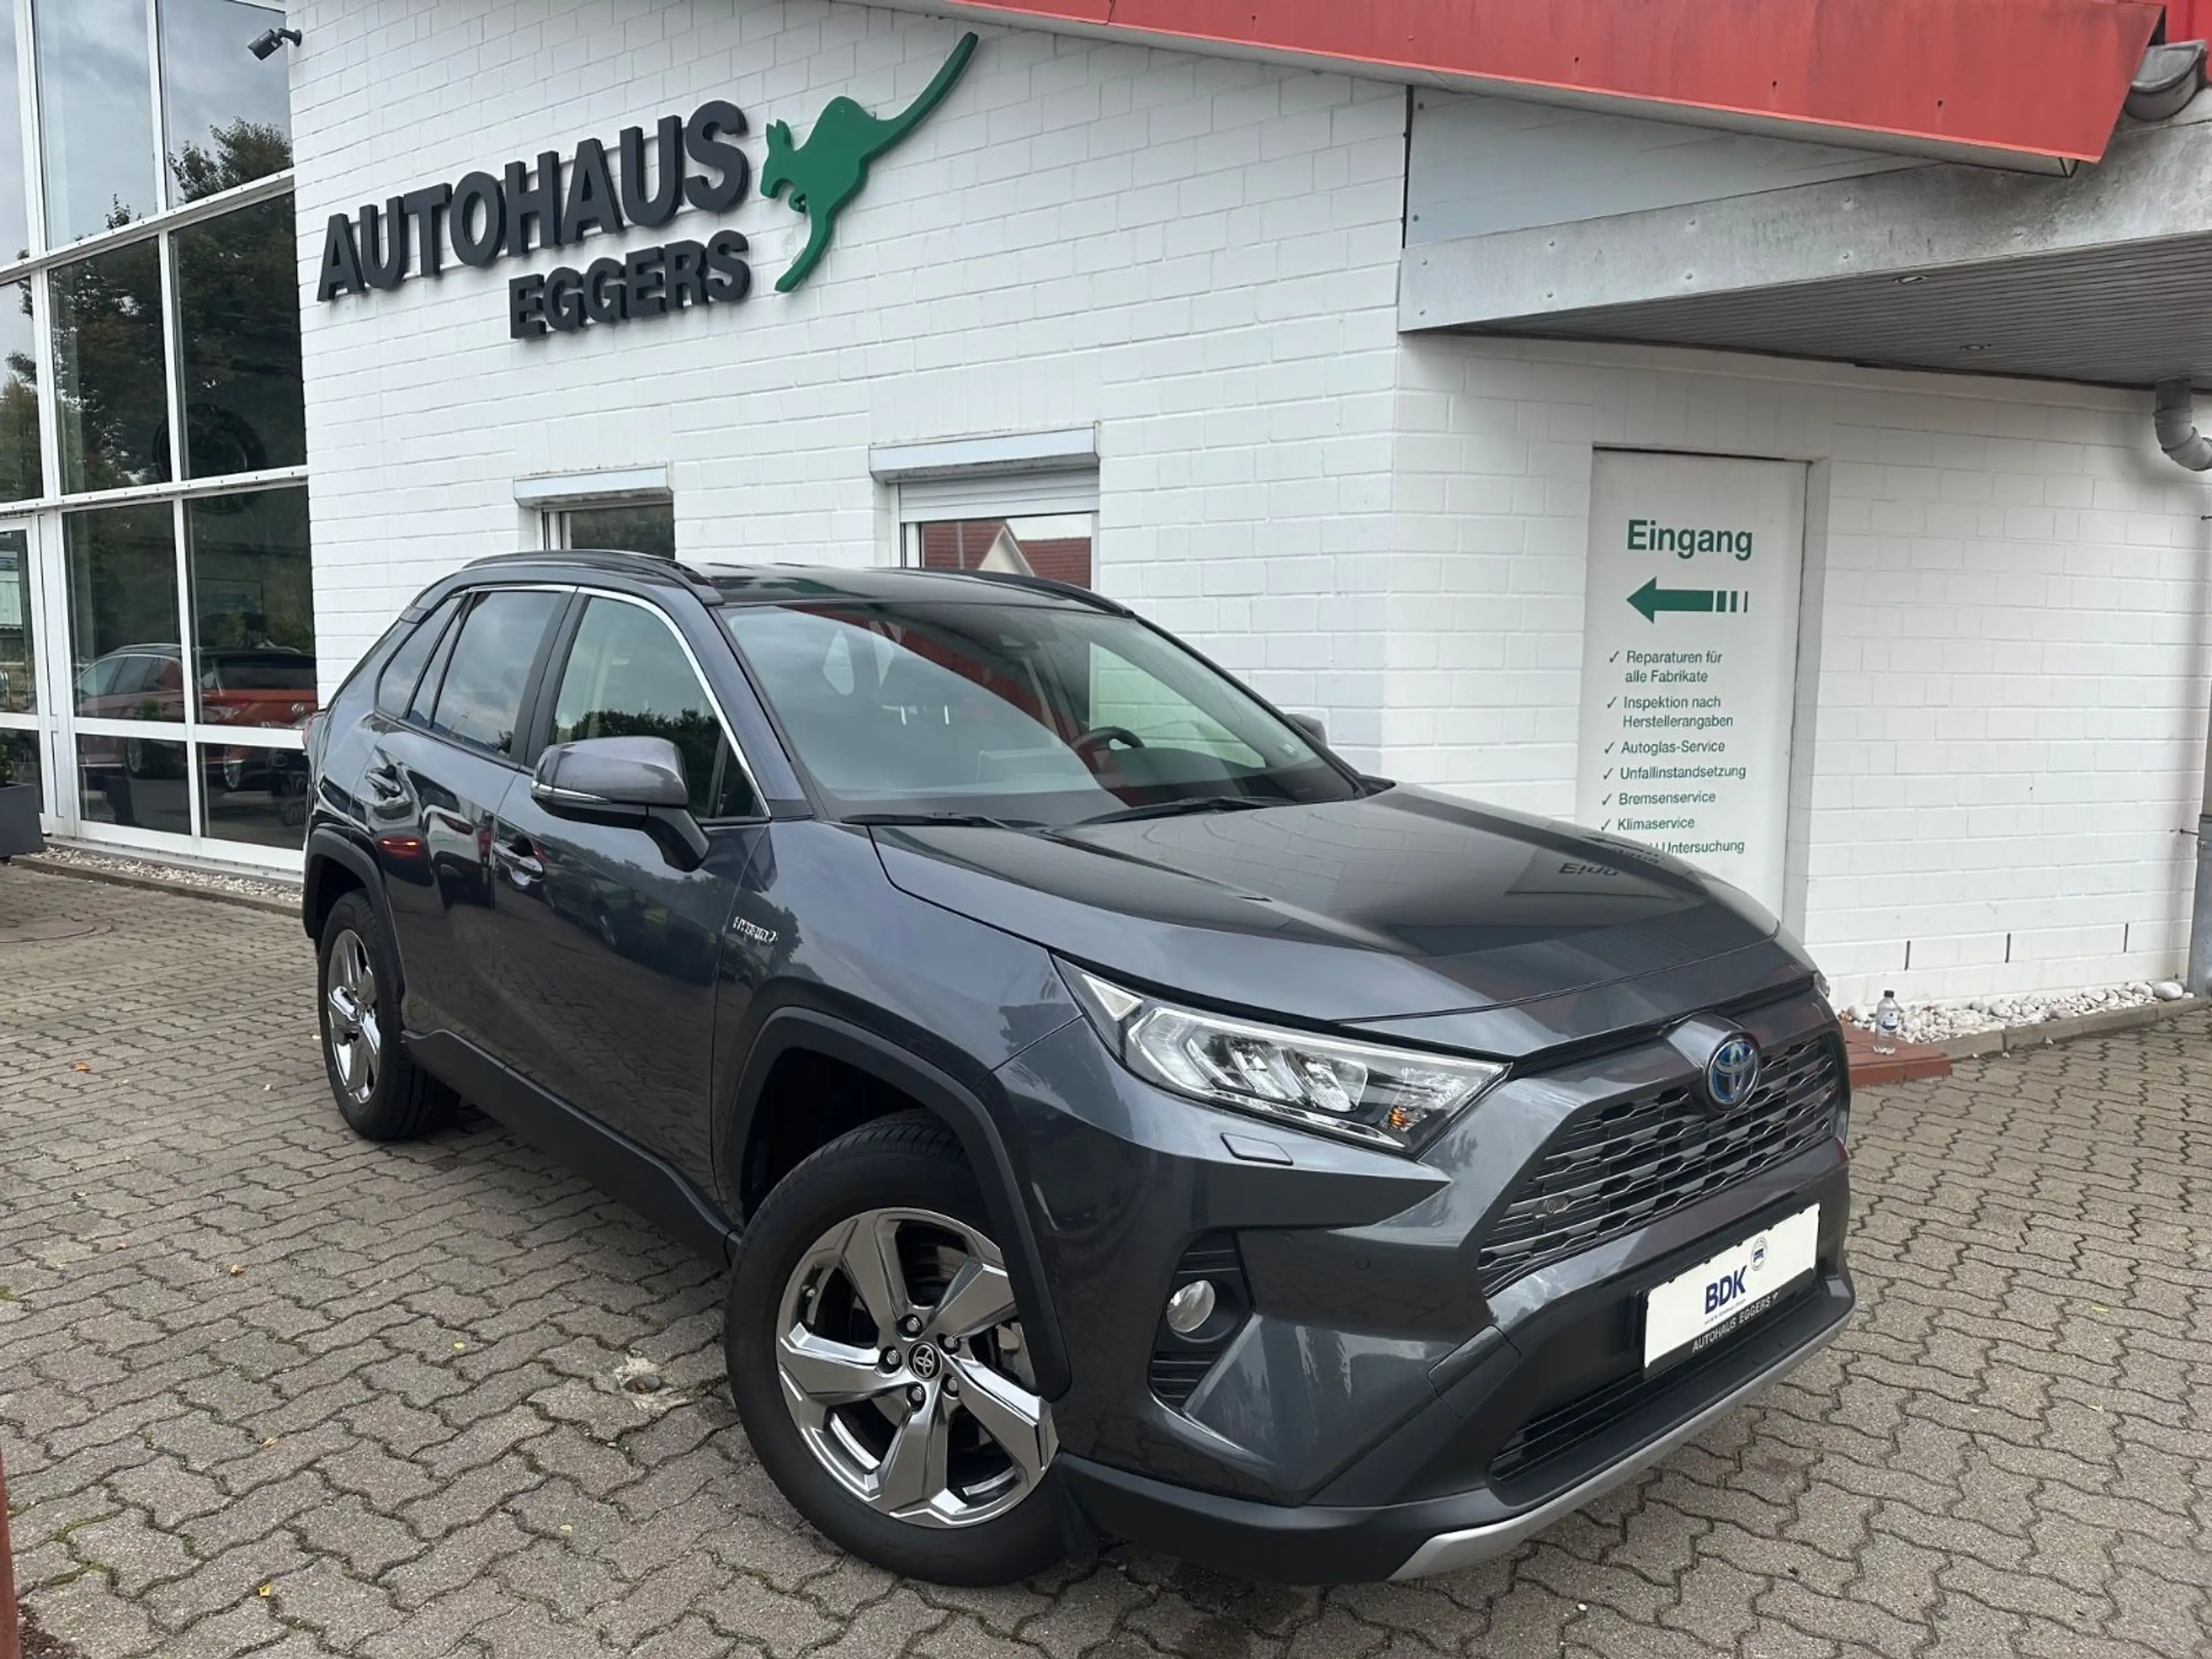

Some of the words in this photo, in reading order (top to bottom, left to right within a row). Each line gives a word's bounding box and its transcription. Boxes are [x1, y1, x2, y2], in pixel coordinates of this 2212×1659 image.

[317, 100, 750, 301] AUTOHAUS
[509, 229, 751, 339] EGGERS
[1627, 518, 1752, 560] Eingang
[1626, 650, 1702, 666] Reparaturen
[1706, 650, 1722, 663] für
[1625, 670, 1647, 683] alle
[1650, 669, 1708, 683] Fabrikate
[1623, 695, 1688, 711] Inspektion
[1692, 695, 1721, 708] nach
[1623, 715, 1733, 730] Herstellerangaben
[1620, 740, 1725, 756] Autoglas-Service
[1620, 766, 1747, 779] Unfallinstandsetzung
[1618, 790, 1716, 805] Bremsenservice
[1616, 817, 1695, 831] Klimaservice
[1661, 839, 1745, 854] Untersuchung
[1705, 1265, 1747, 1315] BDK
[1692, 1316, 1737, 1353] AUTOHAUS
[1738, 1296, 1771, 1324] EGGERS
